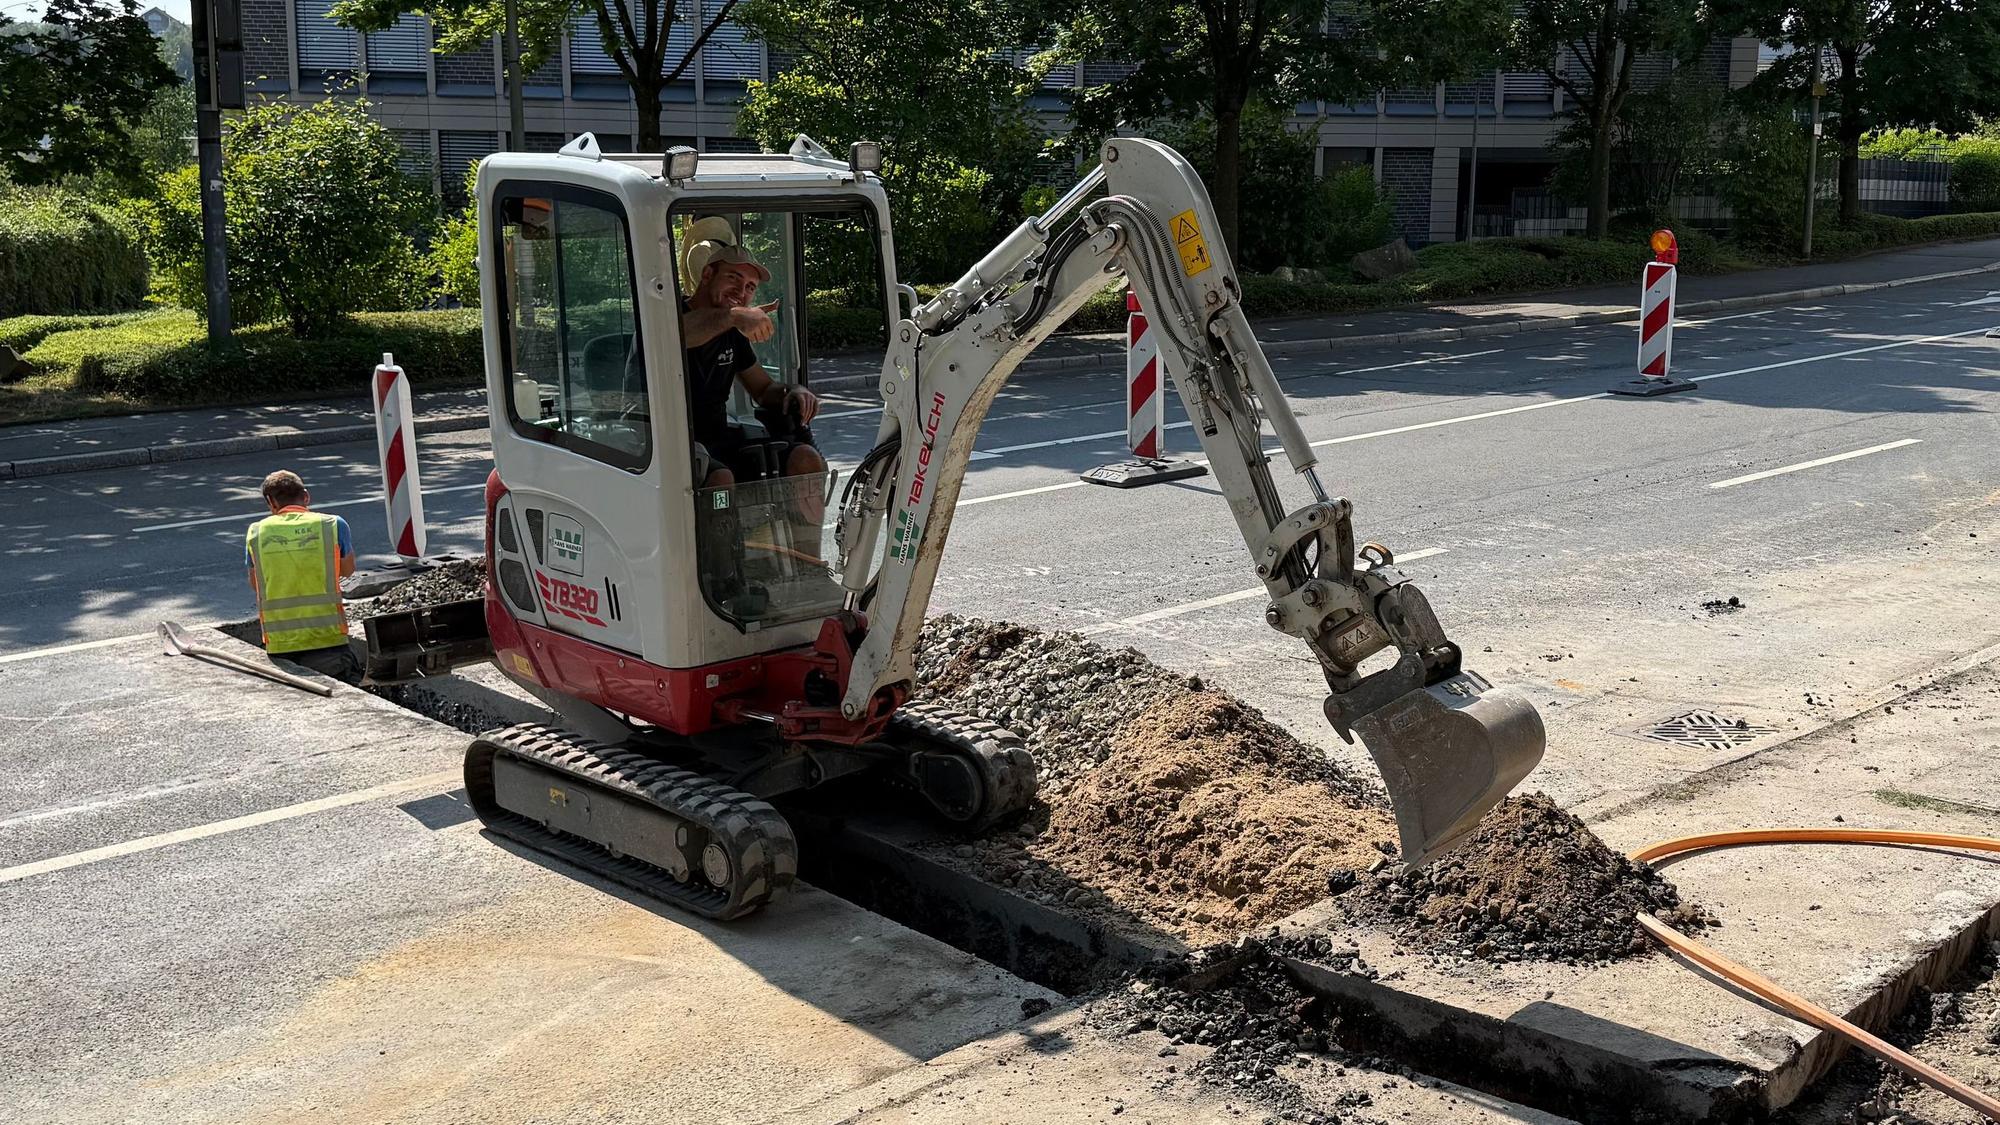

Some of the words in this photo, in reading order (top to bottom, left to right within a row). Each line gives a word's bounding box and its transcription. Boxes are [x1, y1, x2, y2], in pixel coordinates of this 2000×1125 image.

[908, 391, 945, 507] TAKEUCHI
[899, 543, 908, 564] HANS
[550, 578, 599, 615] TB320
